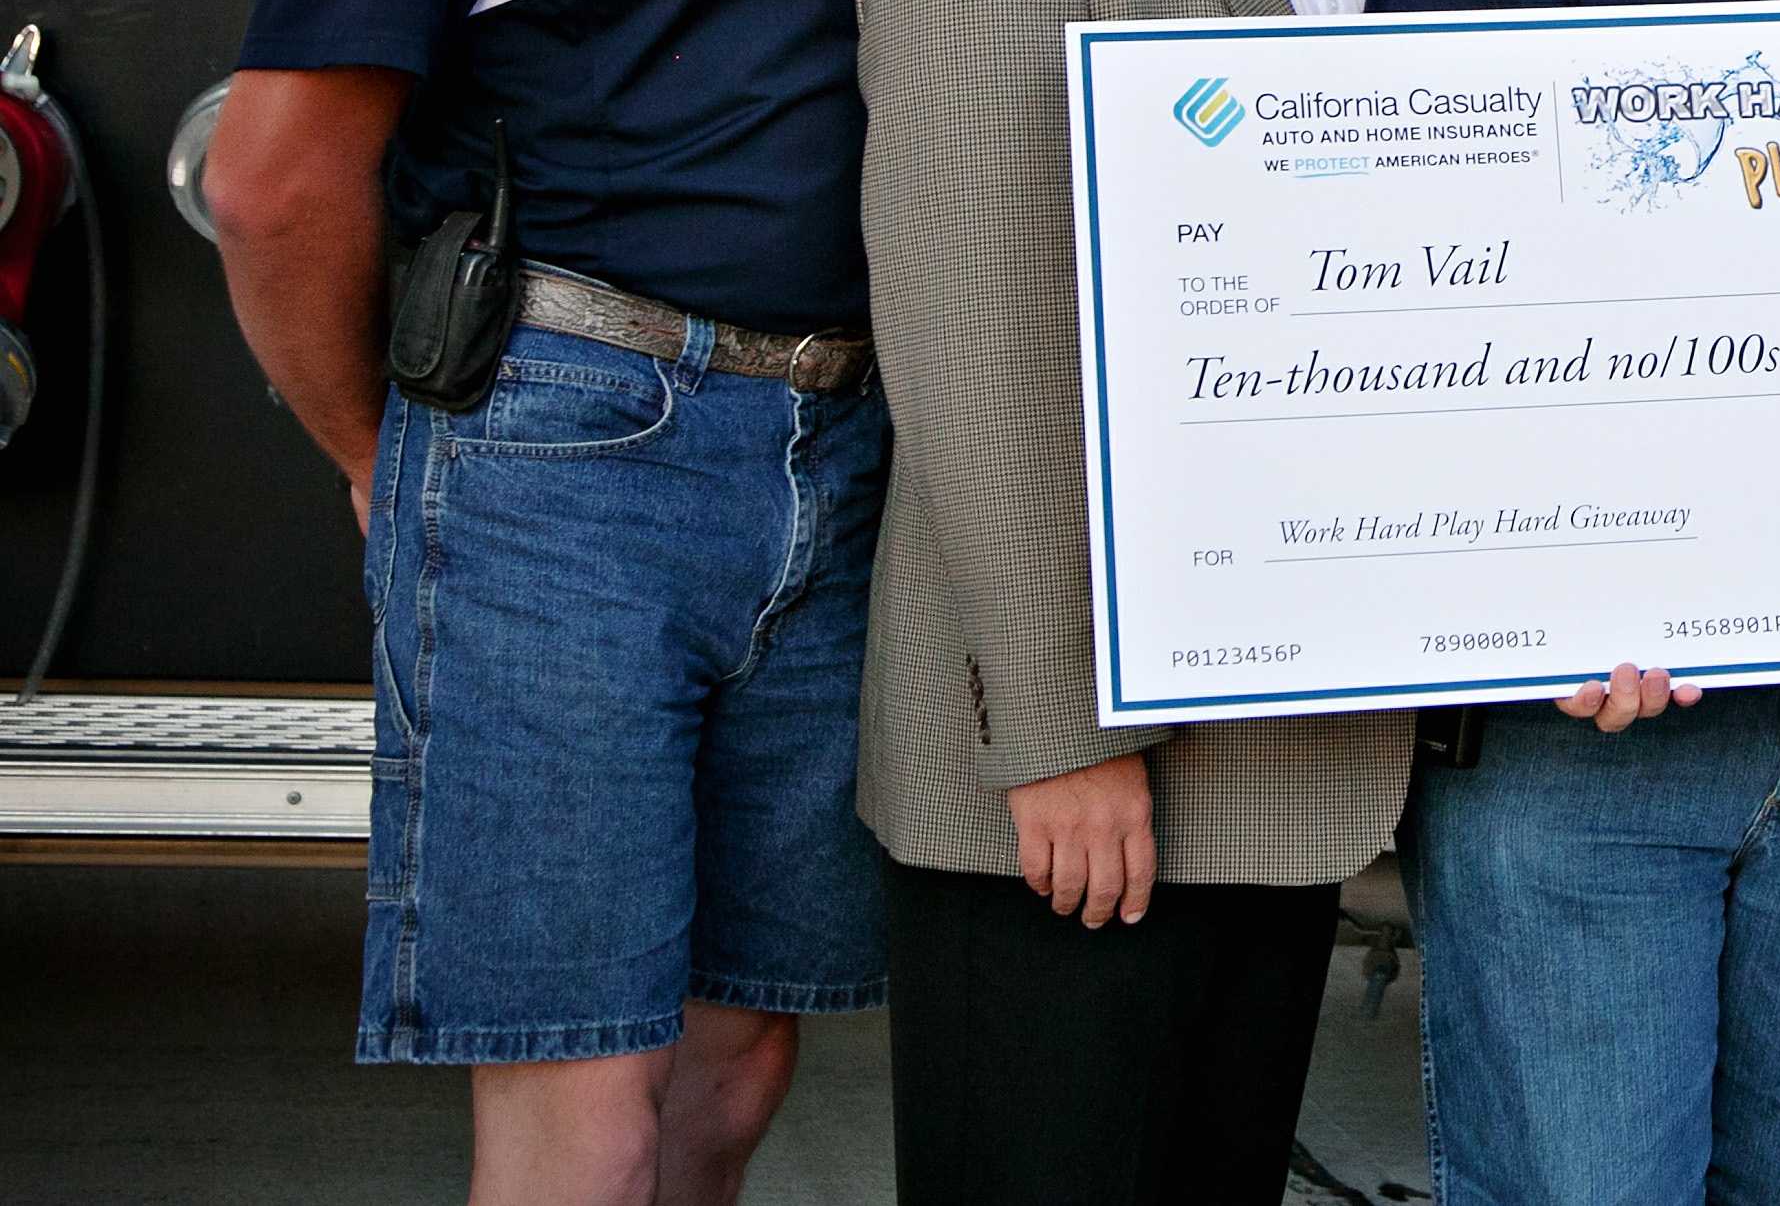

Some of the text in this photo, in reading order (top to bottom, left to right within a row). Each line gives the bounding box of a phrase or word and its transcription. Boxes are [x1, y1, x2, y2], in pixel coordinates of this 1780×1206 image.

[1256, 86, 1542, 120] California Casualty
[1571, 80, 1731, 124] WORK
[1262, 123, 1537, 145] AUTO AND HOME INSURANCE
[1264, 160, 1289, 171] WE
[1295, 157, 1369, 170] PROTECT
[1375, 154, 1459, 168] AMERICAN
[1178, 223, 1224, 243] PAY
[1309, 240, 1509, 291] Tom Vail
[1179, 276, 1248, 292] TO THE
[1181, 298, 1280, 316] ORDER OF
[1186, 334, 1780, 399] Ten-thousand and no/100s
[1280, 505, 1691, 544] Work Hard Play Hard Giveaway
[1194, 550, 1233, 566] FOR
[1173, 644, 1301, 667] P0123456P
[1421, 630, 1546, 653] 789000012
